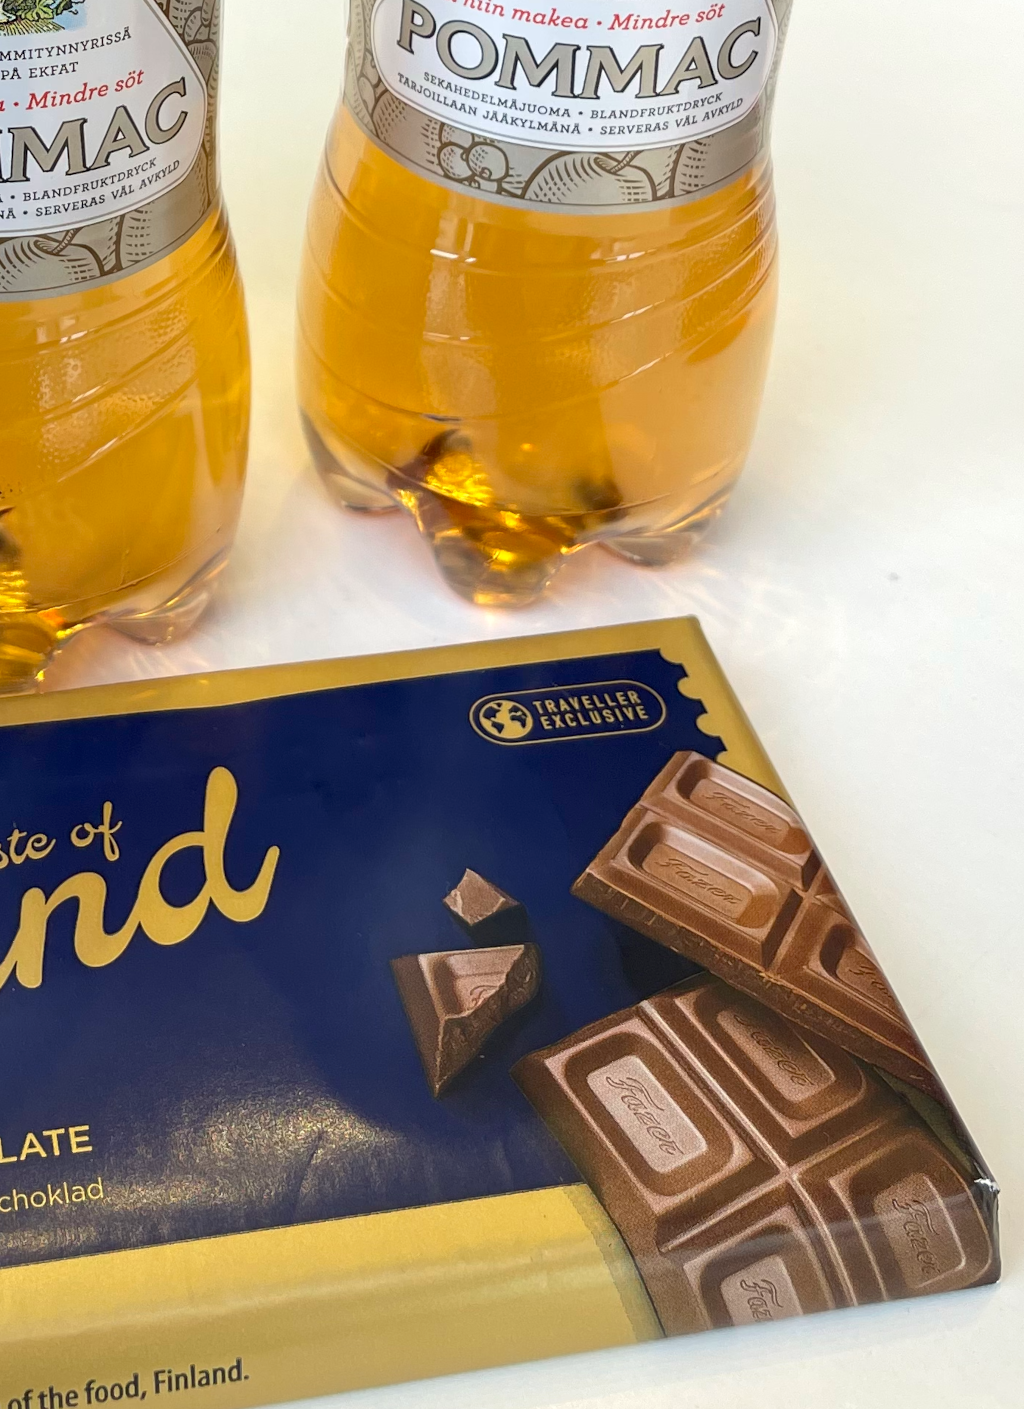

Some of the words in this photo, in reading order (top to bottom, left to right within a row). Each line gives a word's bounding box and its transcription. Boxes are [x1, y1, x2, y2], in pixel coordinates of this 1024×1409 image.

[511, 7, 588, 30] makea
[608, 4, 689, 31] Mindre
[695, 1, 726, 21] söt
[1, 66, 22, 81] PÅ
[28, 61, 79, 78] EKFAT
[26, 82, 109, 112] Mindre
[114, 69, 145, 92] söt
[398, 72, 477, 116] TARJOILLAAN
[600, 121, 669, 135] SERVERAS
[674, 111, 698, 129] VÄL
[701, 98, 743, 122] AVKYLD
[423, 71, 571, 118] SEKAHEDELMÄJUOMA
[590, 92, 723, 120] BLANDFRUKTDRYCK
[22, 157, 157, 202] BLANDFRUKTDRYCK
[36, 195, 106, 217] SERVERAS
[111, 185, 135, 201] VÄL
[139, 159, 181, 192] AVKYLD
[532, 690, 641, 714] TRAVELLER
[540, 706, 649, 730] EXCLUSIVE
[70, 801, 122, 861] of
[606, 1076, 682, 1156] Fazer
[740, 1278, 782, 1323] Faz
[38, 1385, 79, 1409] the
[85, 1372, 147, 1402] food,
[153, 1357, 250, 1394] Finland.
